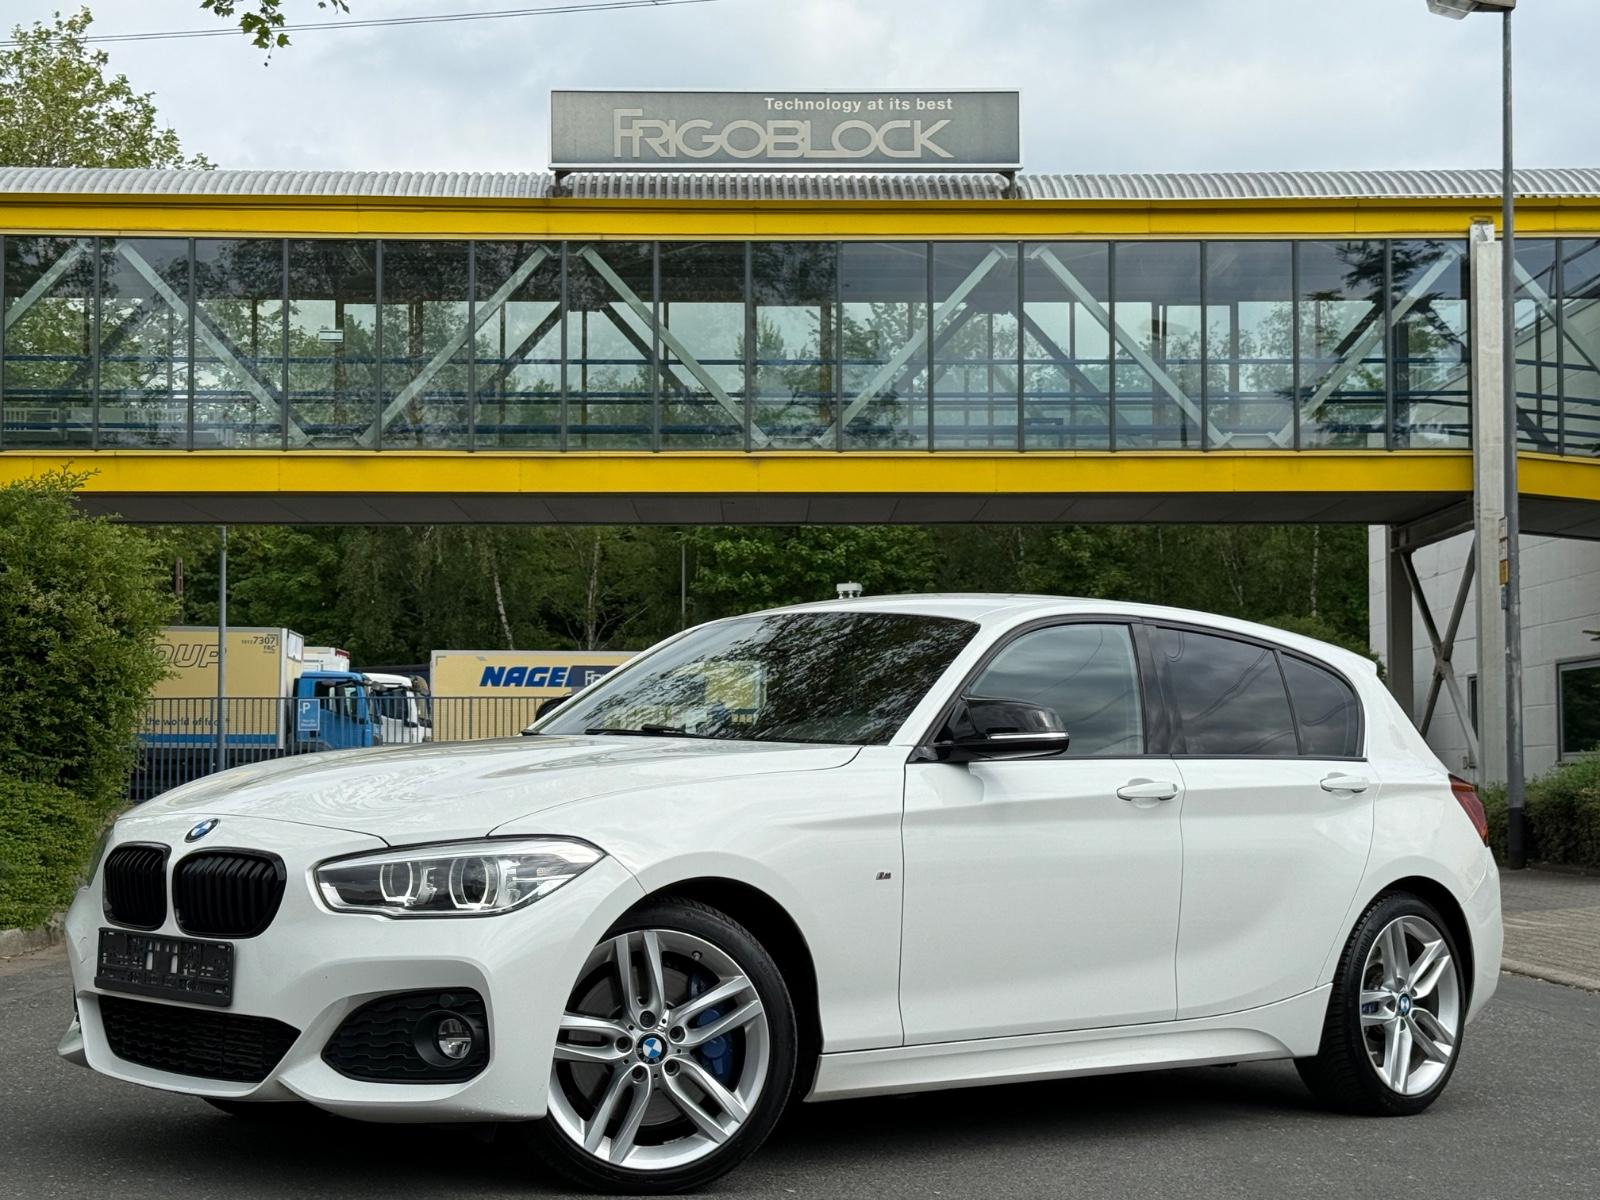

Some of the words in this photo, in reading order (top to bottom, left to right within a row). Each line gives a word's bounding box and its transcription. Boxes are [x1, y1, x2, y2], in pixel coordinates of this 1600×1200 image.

[764, 97, 862, 113] Technology
[867, 98, 884, 111] at
[889, 97, 911, 111] its
[916, 97, 953, 111] best
[613, 108, 955, 159] FRIGOBLOCK
[302, 702, 311, 715] P
